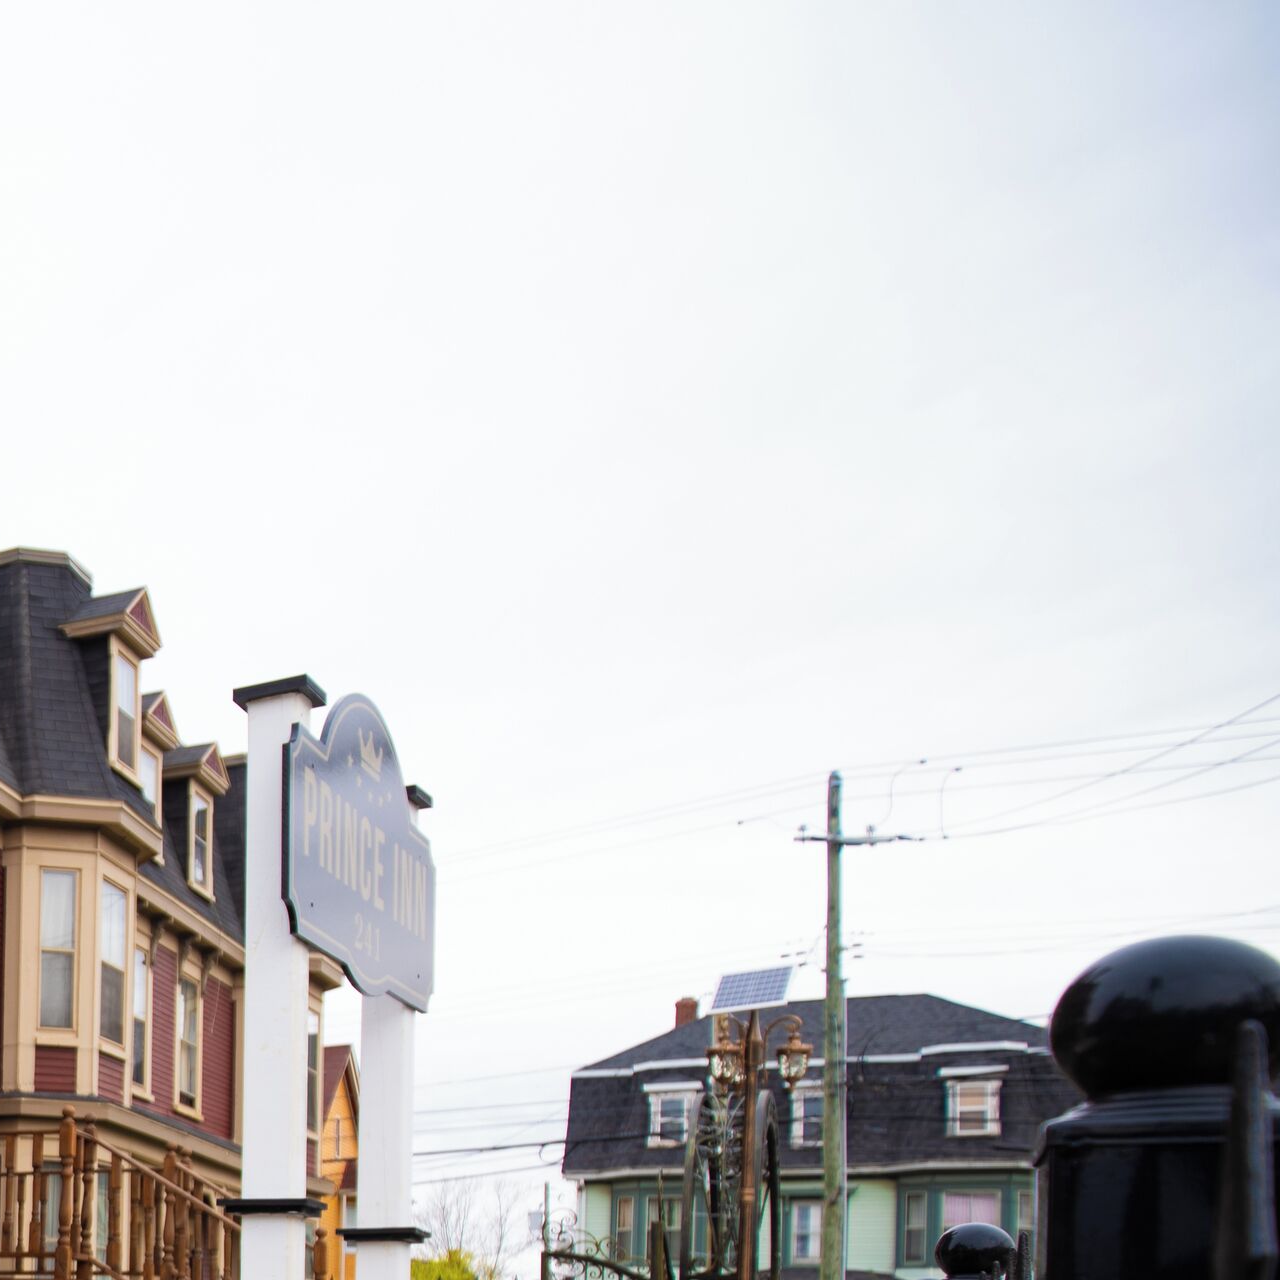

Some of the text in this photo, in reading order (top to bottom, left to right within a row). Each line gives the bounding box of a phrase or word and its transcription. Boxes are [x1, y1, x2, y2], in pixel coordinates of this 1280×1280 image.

[304, 766, 427, 941] PRINCE INN
[354, 911, 380, 962] 241
